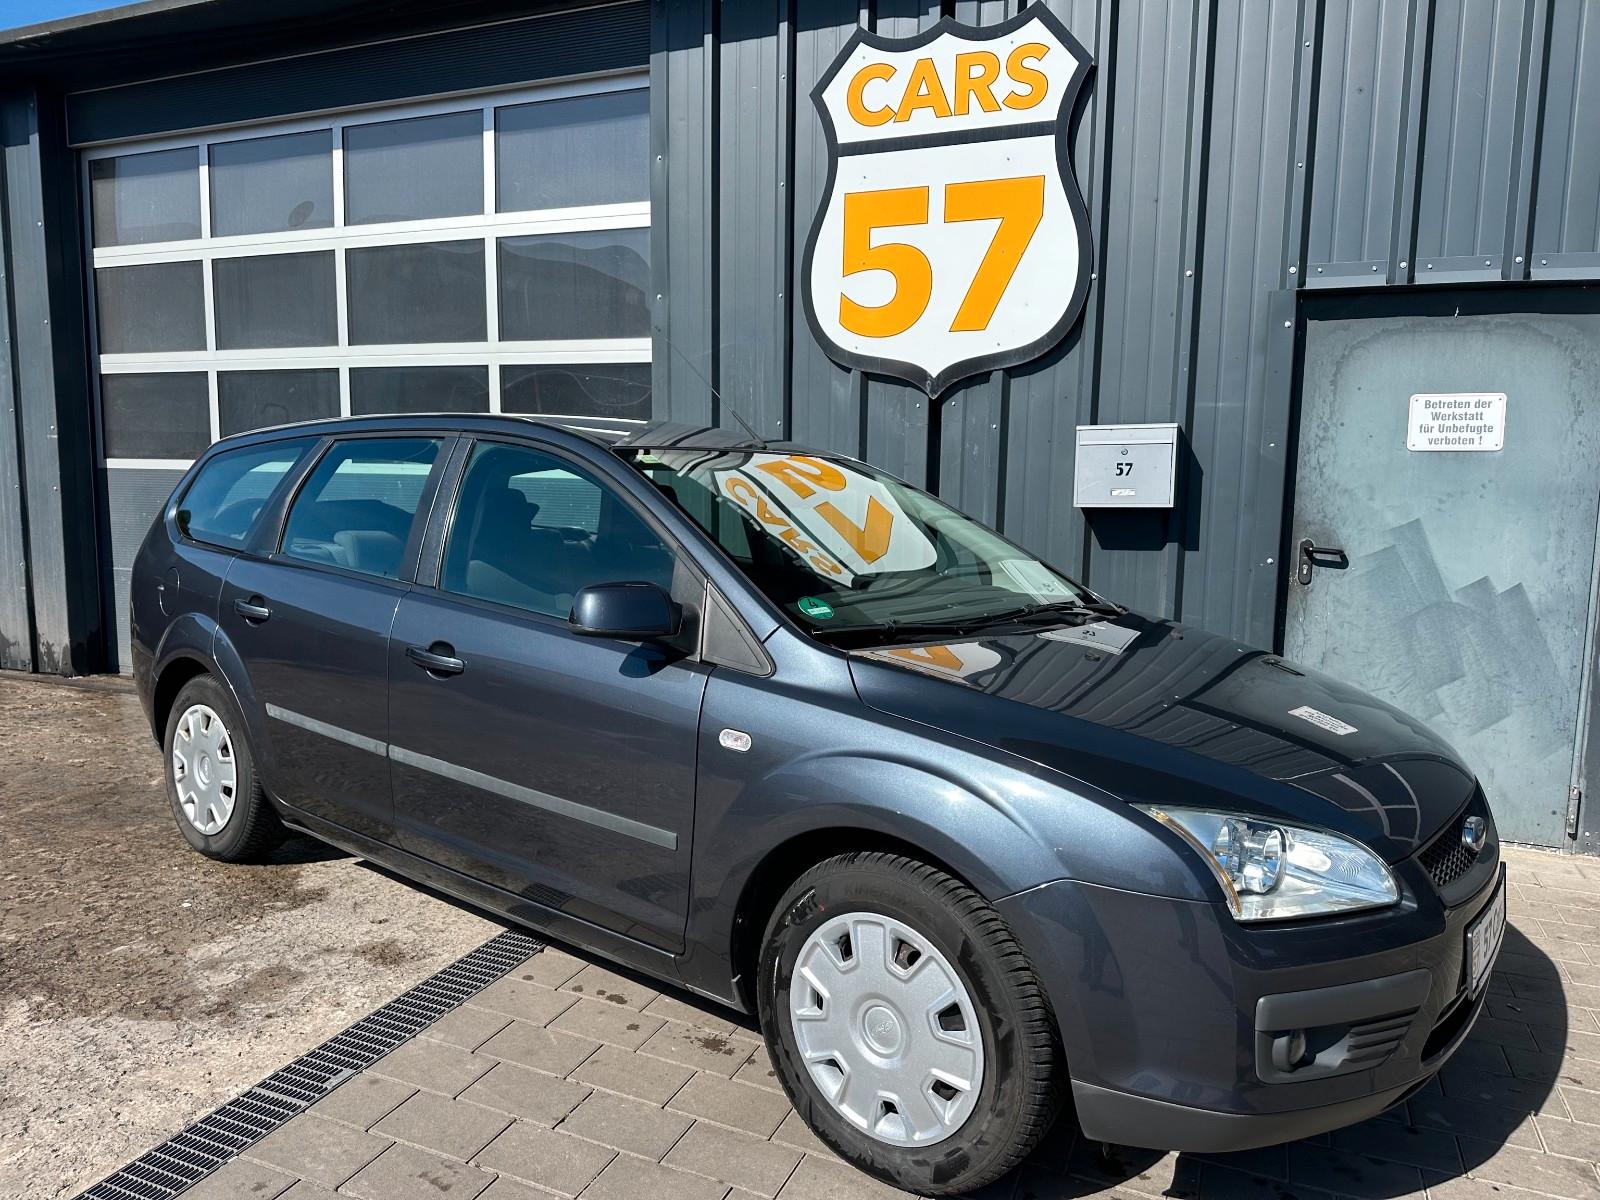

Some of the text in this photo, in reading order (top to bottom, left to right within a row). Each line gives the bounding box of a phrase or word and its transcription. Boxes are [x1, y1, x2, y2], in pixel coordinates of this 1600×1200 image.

[846, 42, 1050, 127] CARS
[839, 174, 1045, 338] 57
[1424, 398, 1493, 409] Betreten der
[1431, 411, 1484, 421] Werkstatt
[1419, 423, 1494, 435] für Unbefugte
[1428, 435, 1475, 446] verboten
[1115, 462, 1133, 477] 57
